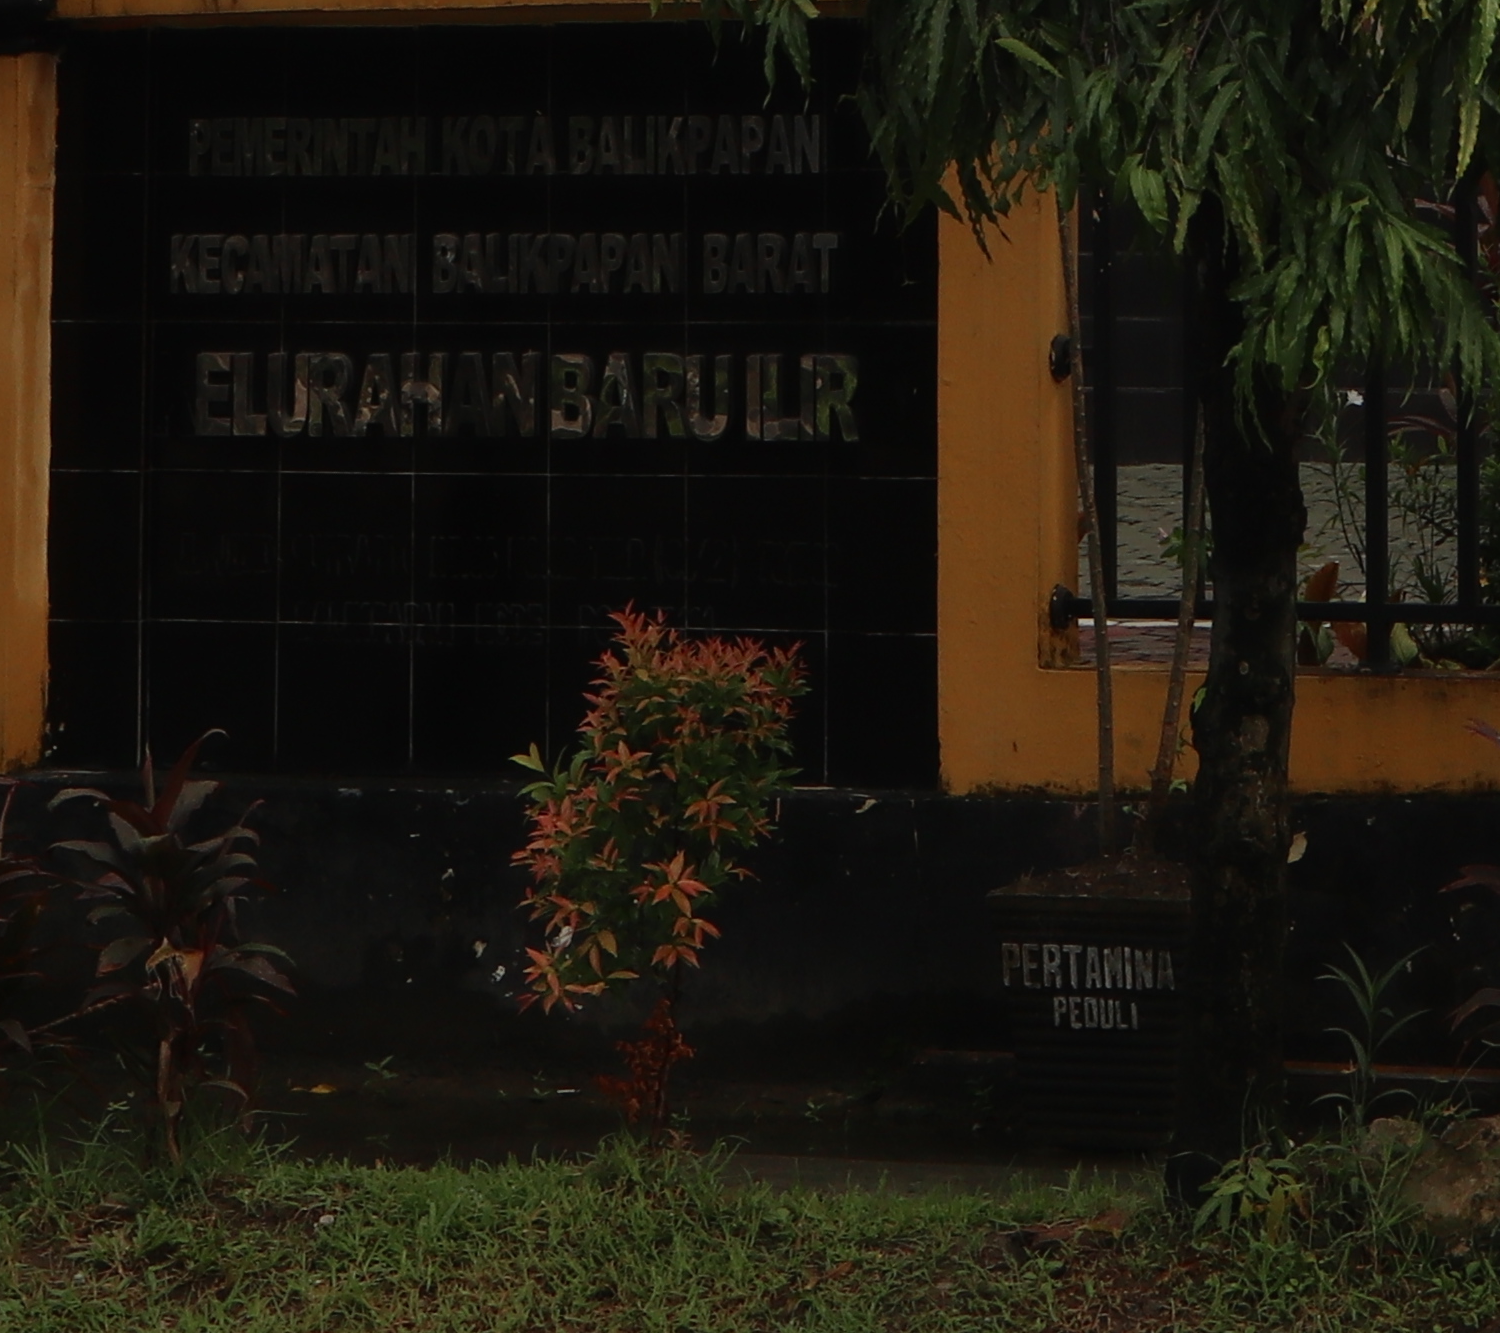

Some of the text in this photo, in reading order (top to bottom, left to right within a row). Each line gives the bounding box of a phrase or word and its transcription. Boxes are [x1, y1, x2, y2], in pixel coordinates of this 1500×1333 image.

[188, 113, 822, 177] PEMERINTAH KOTA BALIKPAPAN
[169, 231, 839, 295] KECAMATAN BALIKPAPAN BARAT
[547, 351, 730, 442] BARU
[744, 351, 861, 443] ILIR
[1001, 942, 1176, 991] PERTAMINA
[1052, 995, 1139, 1031] PEDULI
